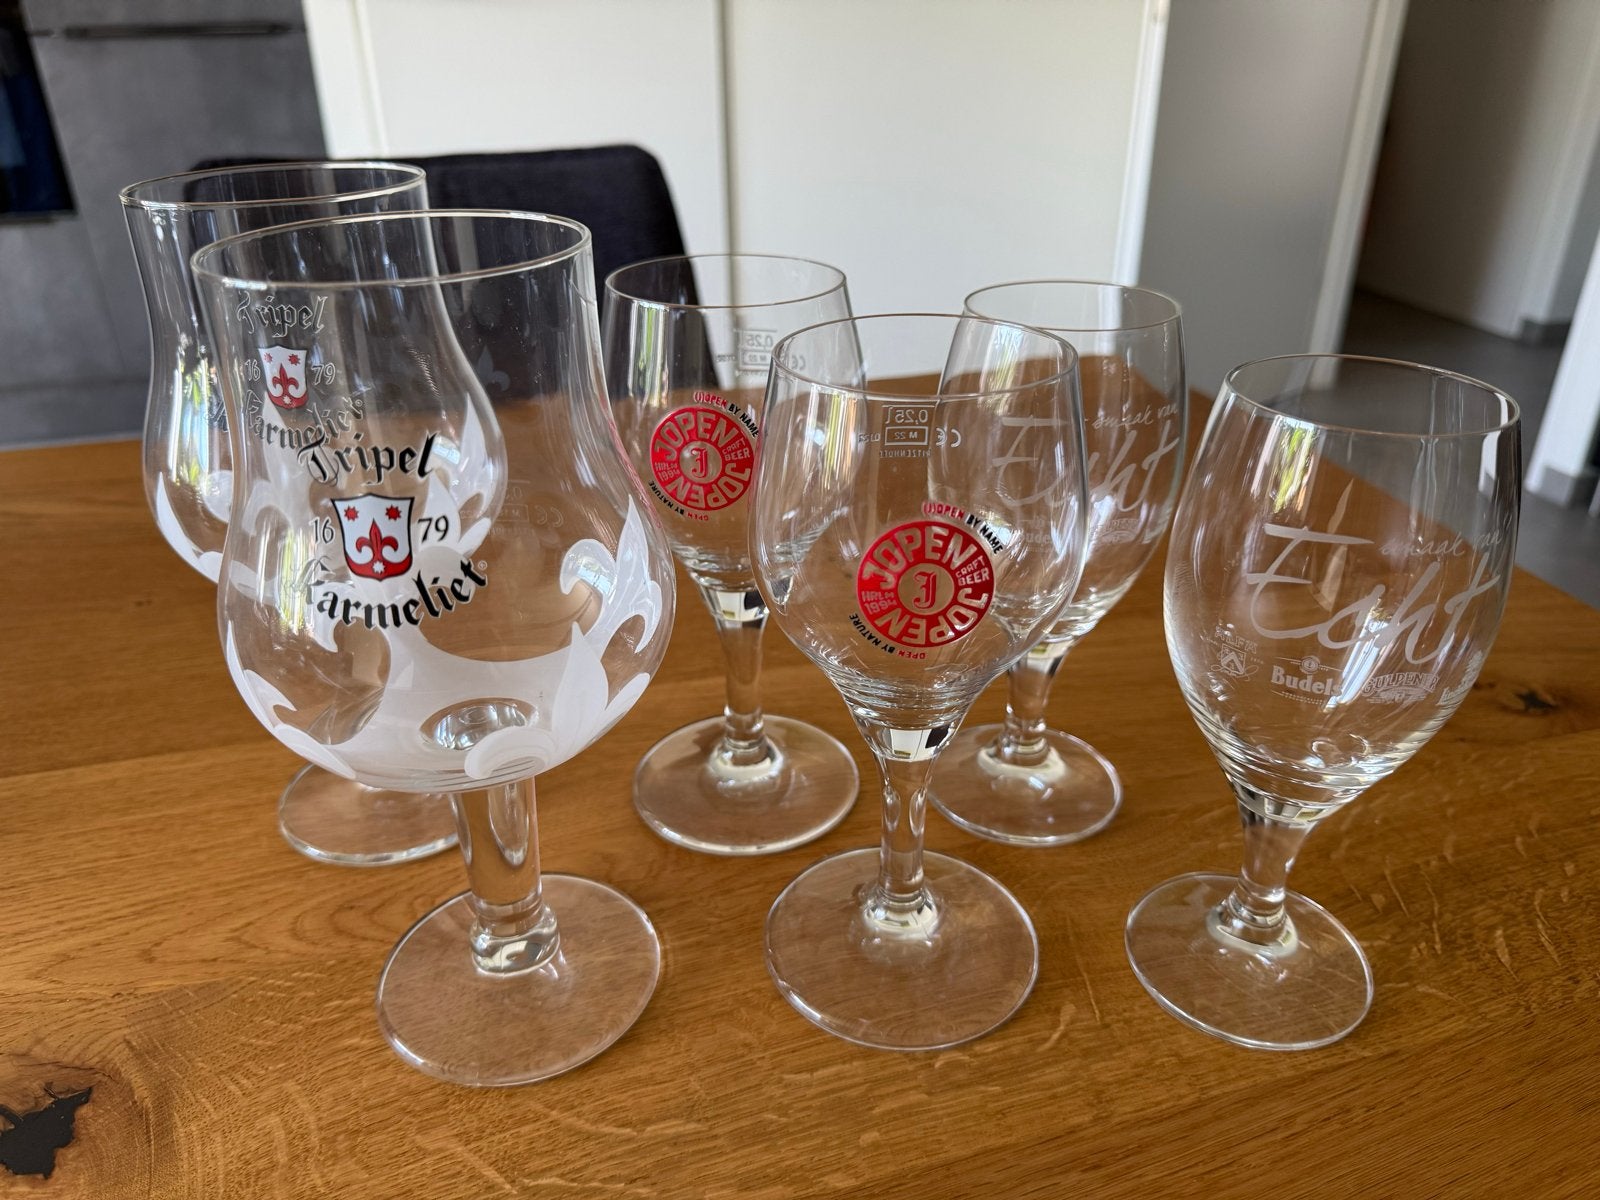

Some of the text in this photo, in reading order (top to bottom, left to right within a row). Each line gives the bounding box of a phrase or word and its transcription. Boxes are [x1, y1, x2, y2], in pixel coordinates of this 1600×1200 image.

[237, 290, 328, 338] Tripel
[245, 359, 336, 386] 16 79
[653, 411, 740, 462] JOPEN
[728, 403, 741, 415] BY
[739, 412, 761, 438] NAME
[297, 431, 441, 487] Tripel
[725, 447, 751, 462] BEER
[648, 480, 674, 508] NATURE
[665, 462, 752, 509] JOPEN
[309, 514, 450, 544] 16 79
[966, 513, 982, 530] BY
[979, 525, 1004, 555] NAME
[862, 525, 978, 591] JOPEN
[955, 554, 987, 579] CRAFT
[957, 566, 990, 587] BEER
[1247, 523, 1502, 665] Echt
[849, 613, 927, 660] OPEN BY NATURE
[874, 587, 989, 645] JOPEN
[1270, 665, 1343, 696] Budels
